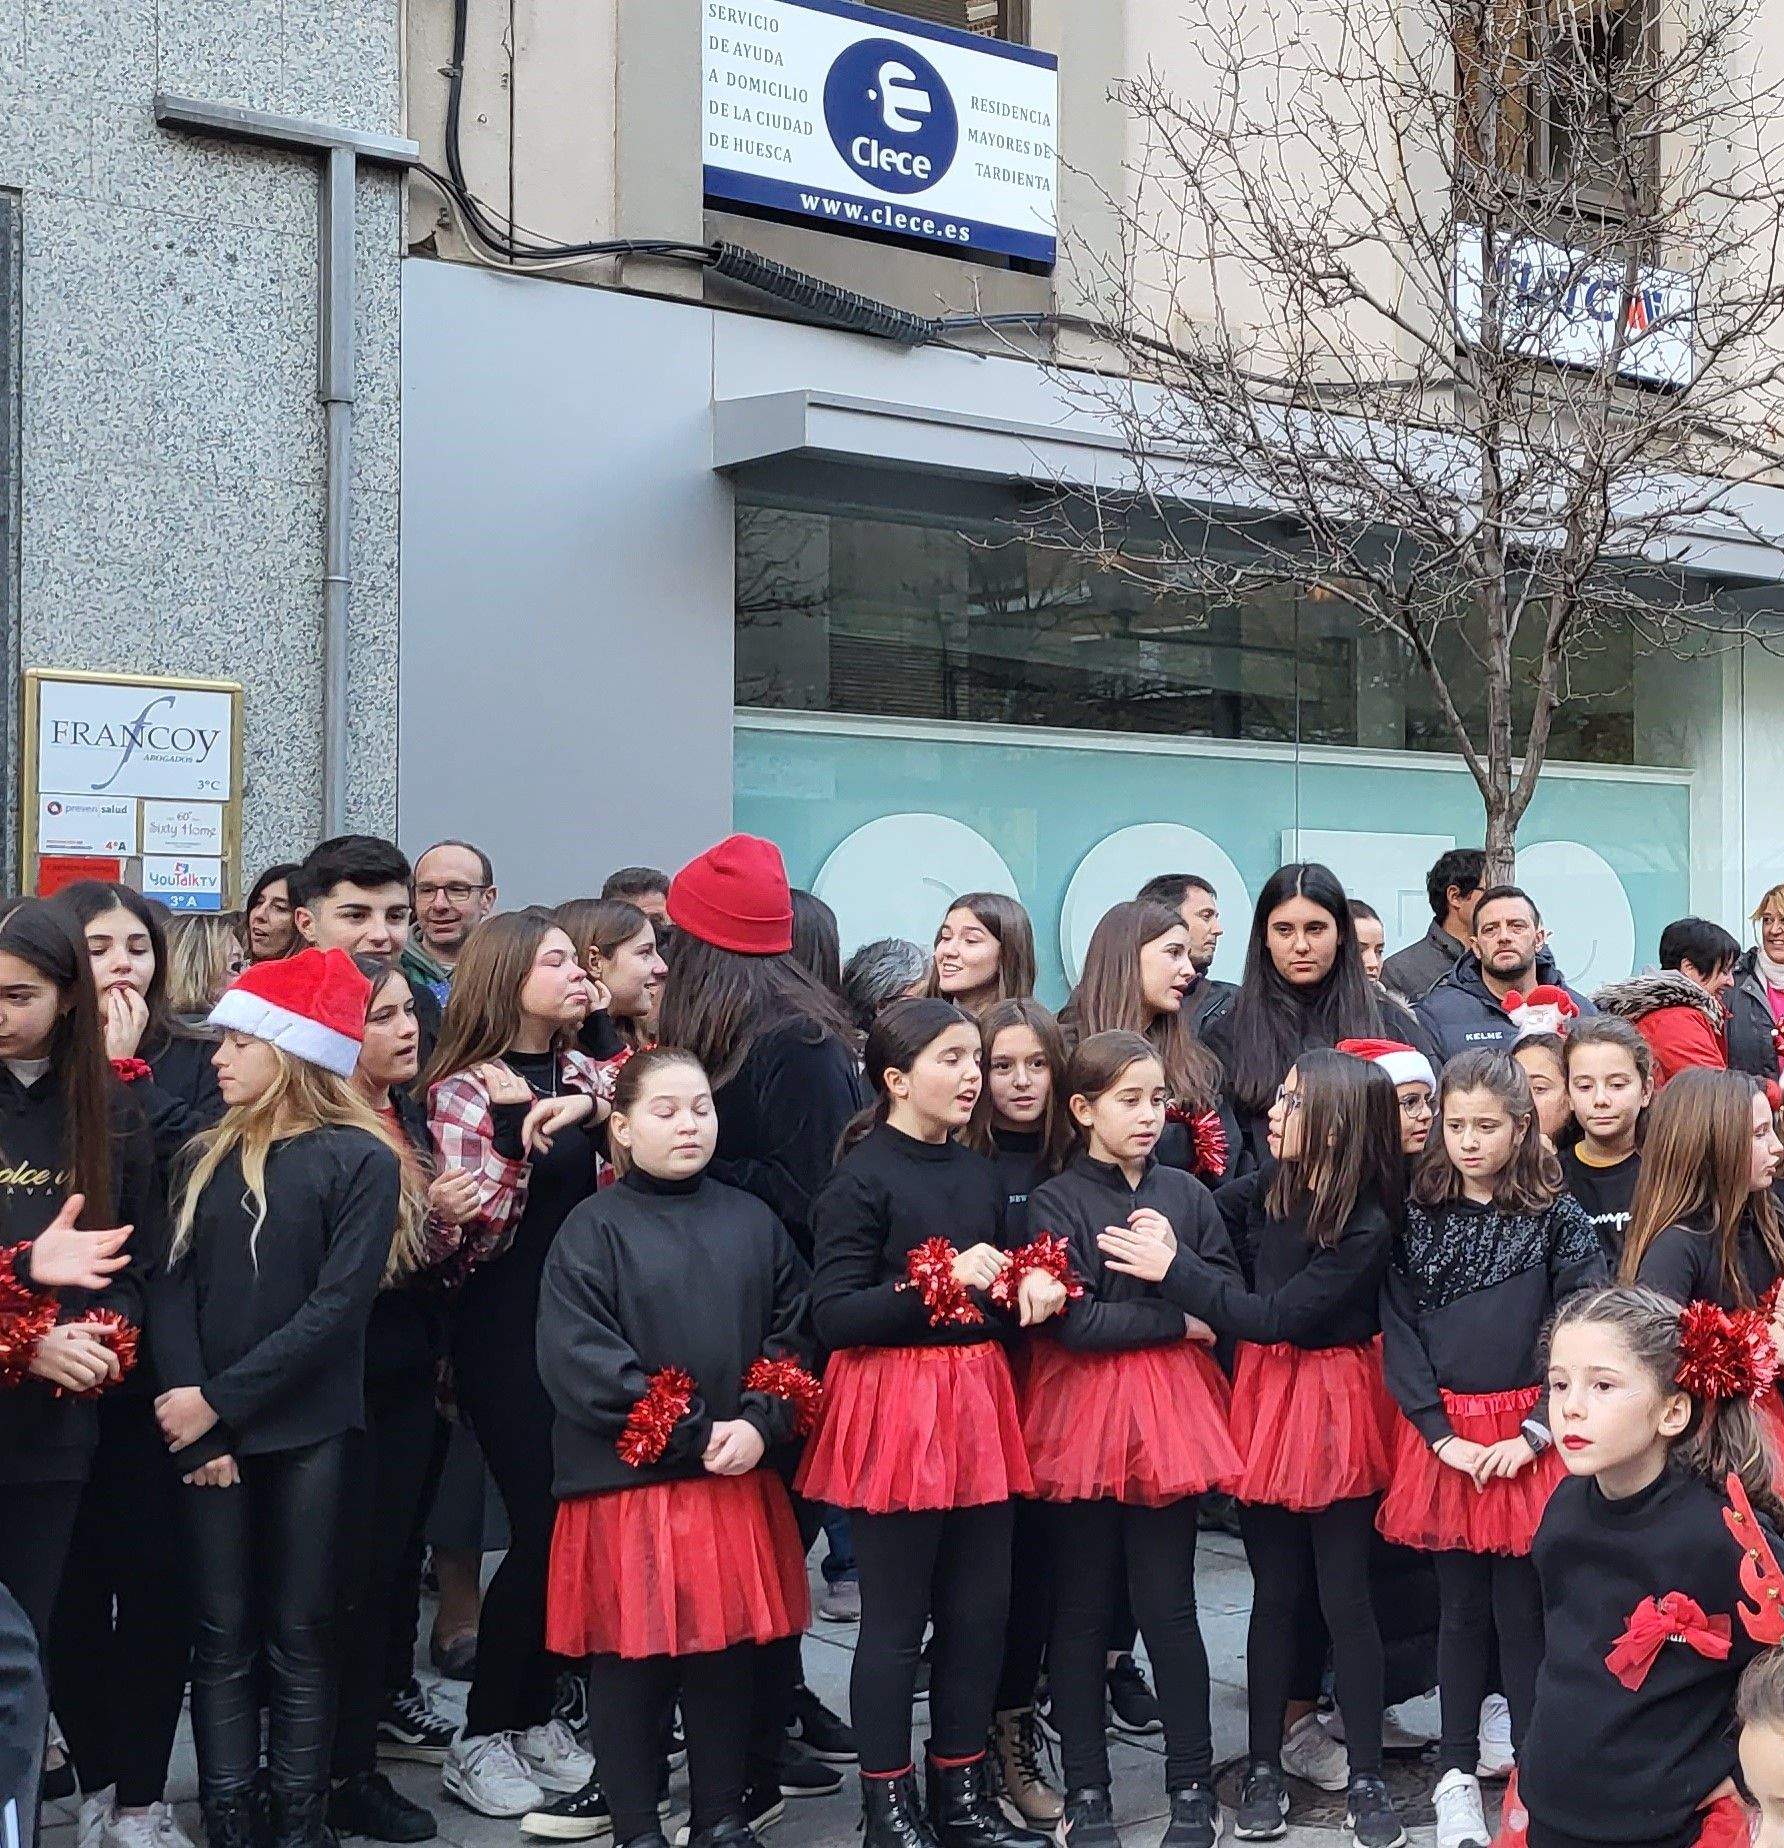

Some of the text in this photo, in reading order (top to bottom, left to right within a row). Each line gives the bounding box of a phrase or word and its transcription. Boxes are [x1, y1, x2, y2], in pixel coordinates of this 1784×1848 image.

[709, 3, 779, 33] SERVICIO
[709, 35, 784, 67] DE AYUDA
[709, 68, 808, 103] A DOMICILIO
[709, 100, 813, 136] DE LA CIUDAD
[971, 96, 1051, 127] RESIDENCIA
[709, 132, 792, 163] DE HUESCA
[851, 136, 932, 179] Clece
[968, 128, 1051, 159] MAYORES DE
[975, 162, 1051, 192] TARDIENTA
[800, 192, 970, 242] www.clece.es
[144, 754, 193, 763] ABOGADOS
[101, 805, 128, 814] salud
[1465, 1031, 1503, 1041] KELME
